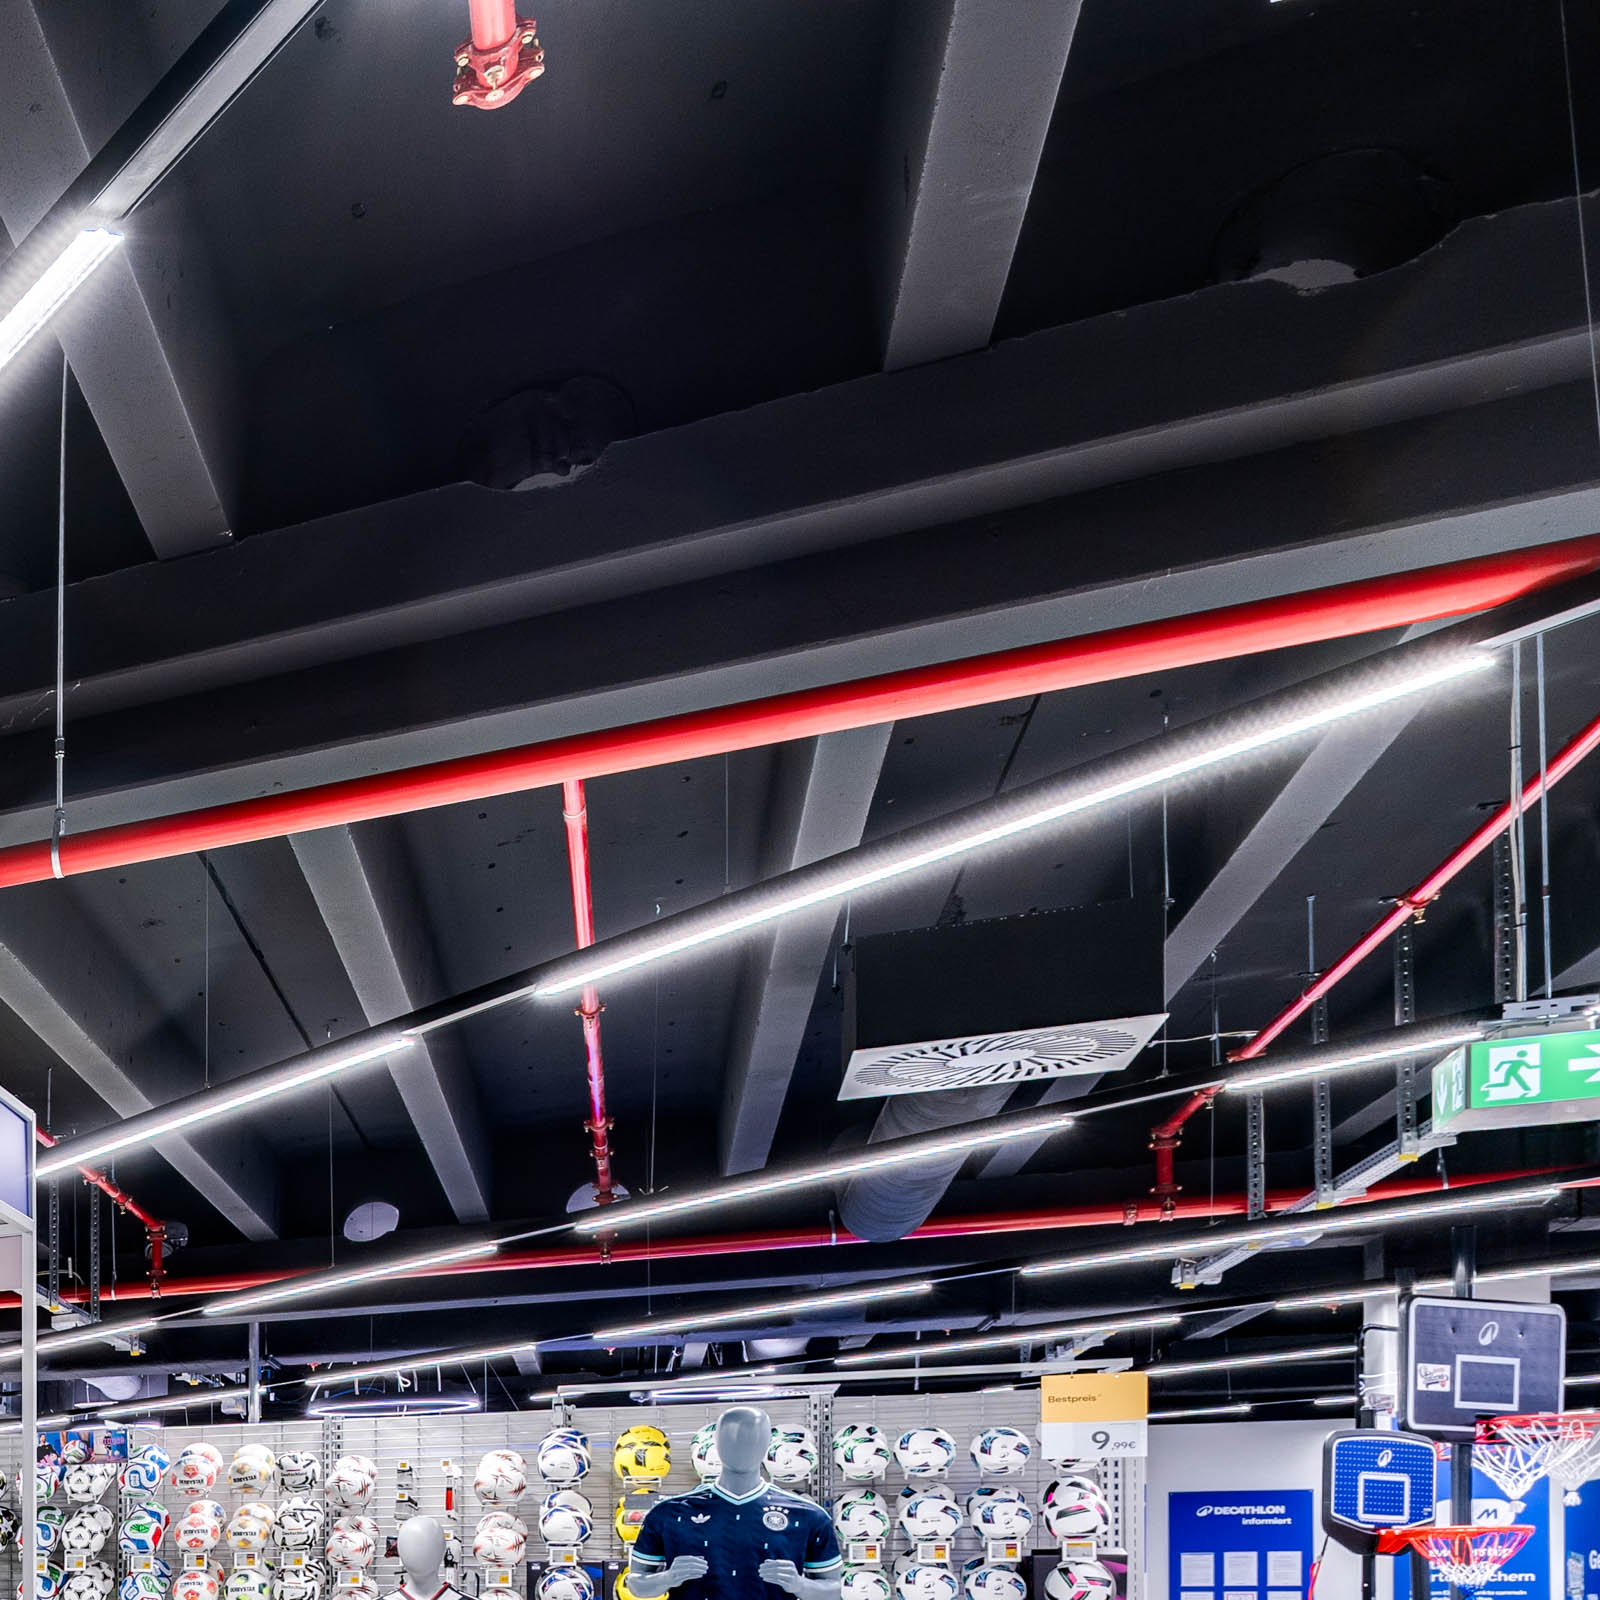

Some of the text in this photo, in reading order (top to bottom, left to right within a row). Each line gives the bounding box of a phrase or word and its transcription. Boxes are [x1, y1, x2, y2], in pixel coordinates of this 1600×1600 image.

[1048, 1393, 1098, 1404] Bestpreis
[1214, 1505, 1286, 1515] DECATHLON
[1242, 1517, 1292, 1526] informiert
